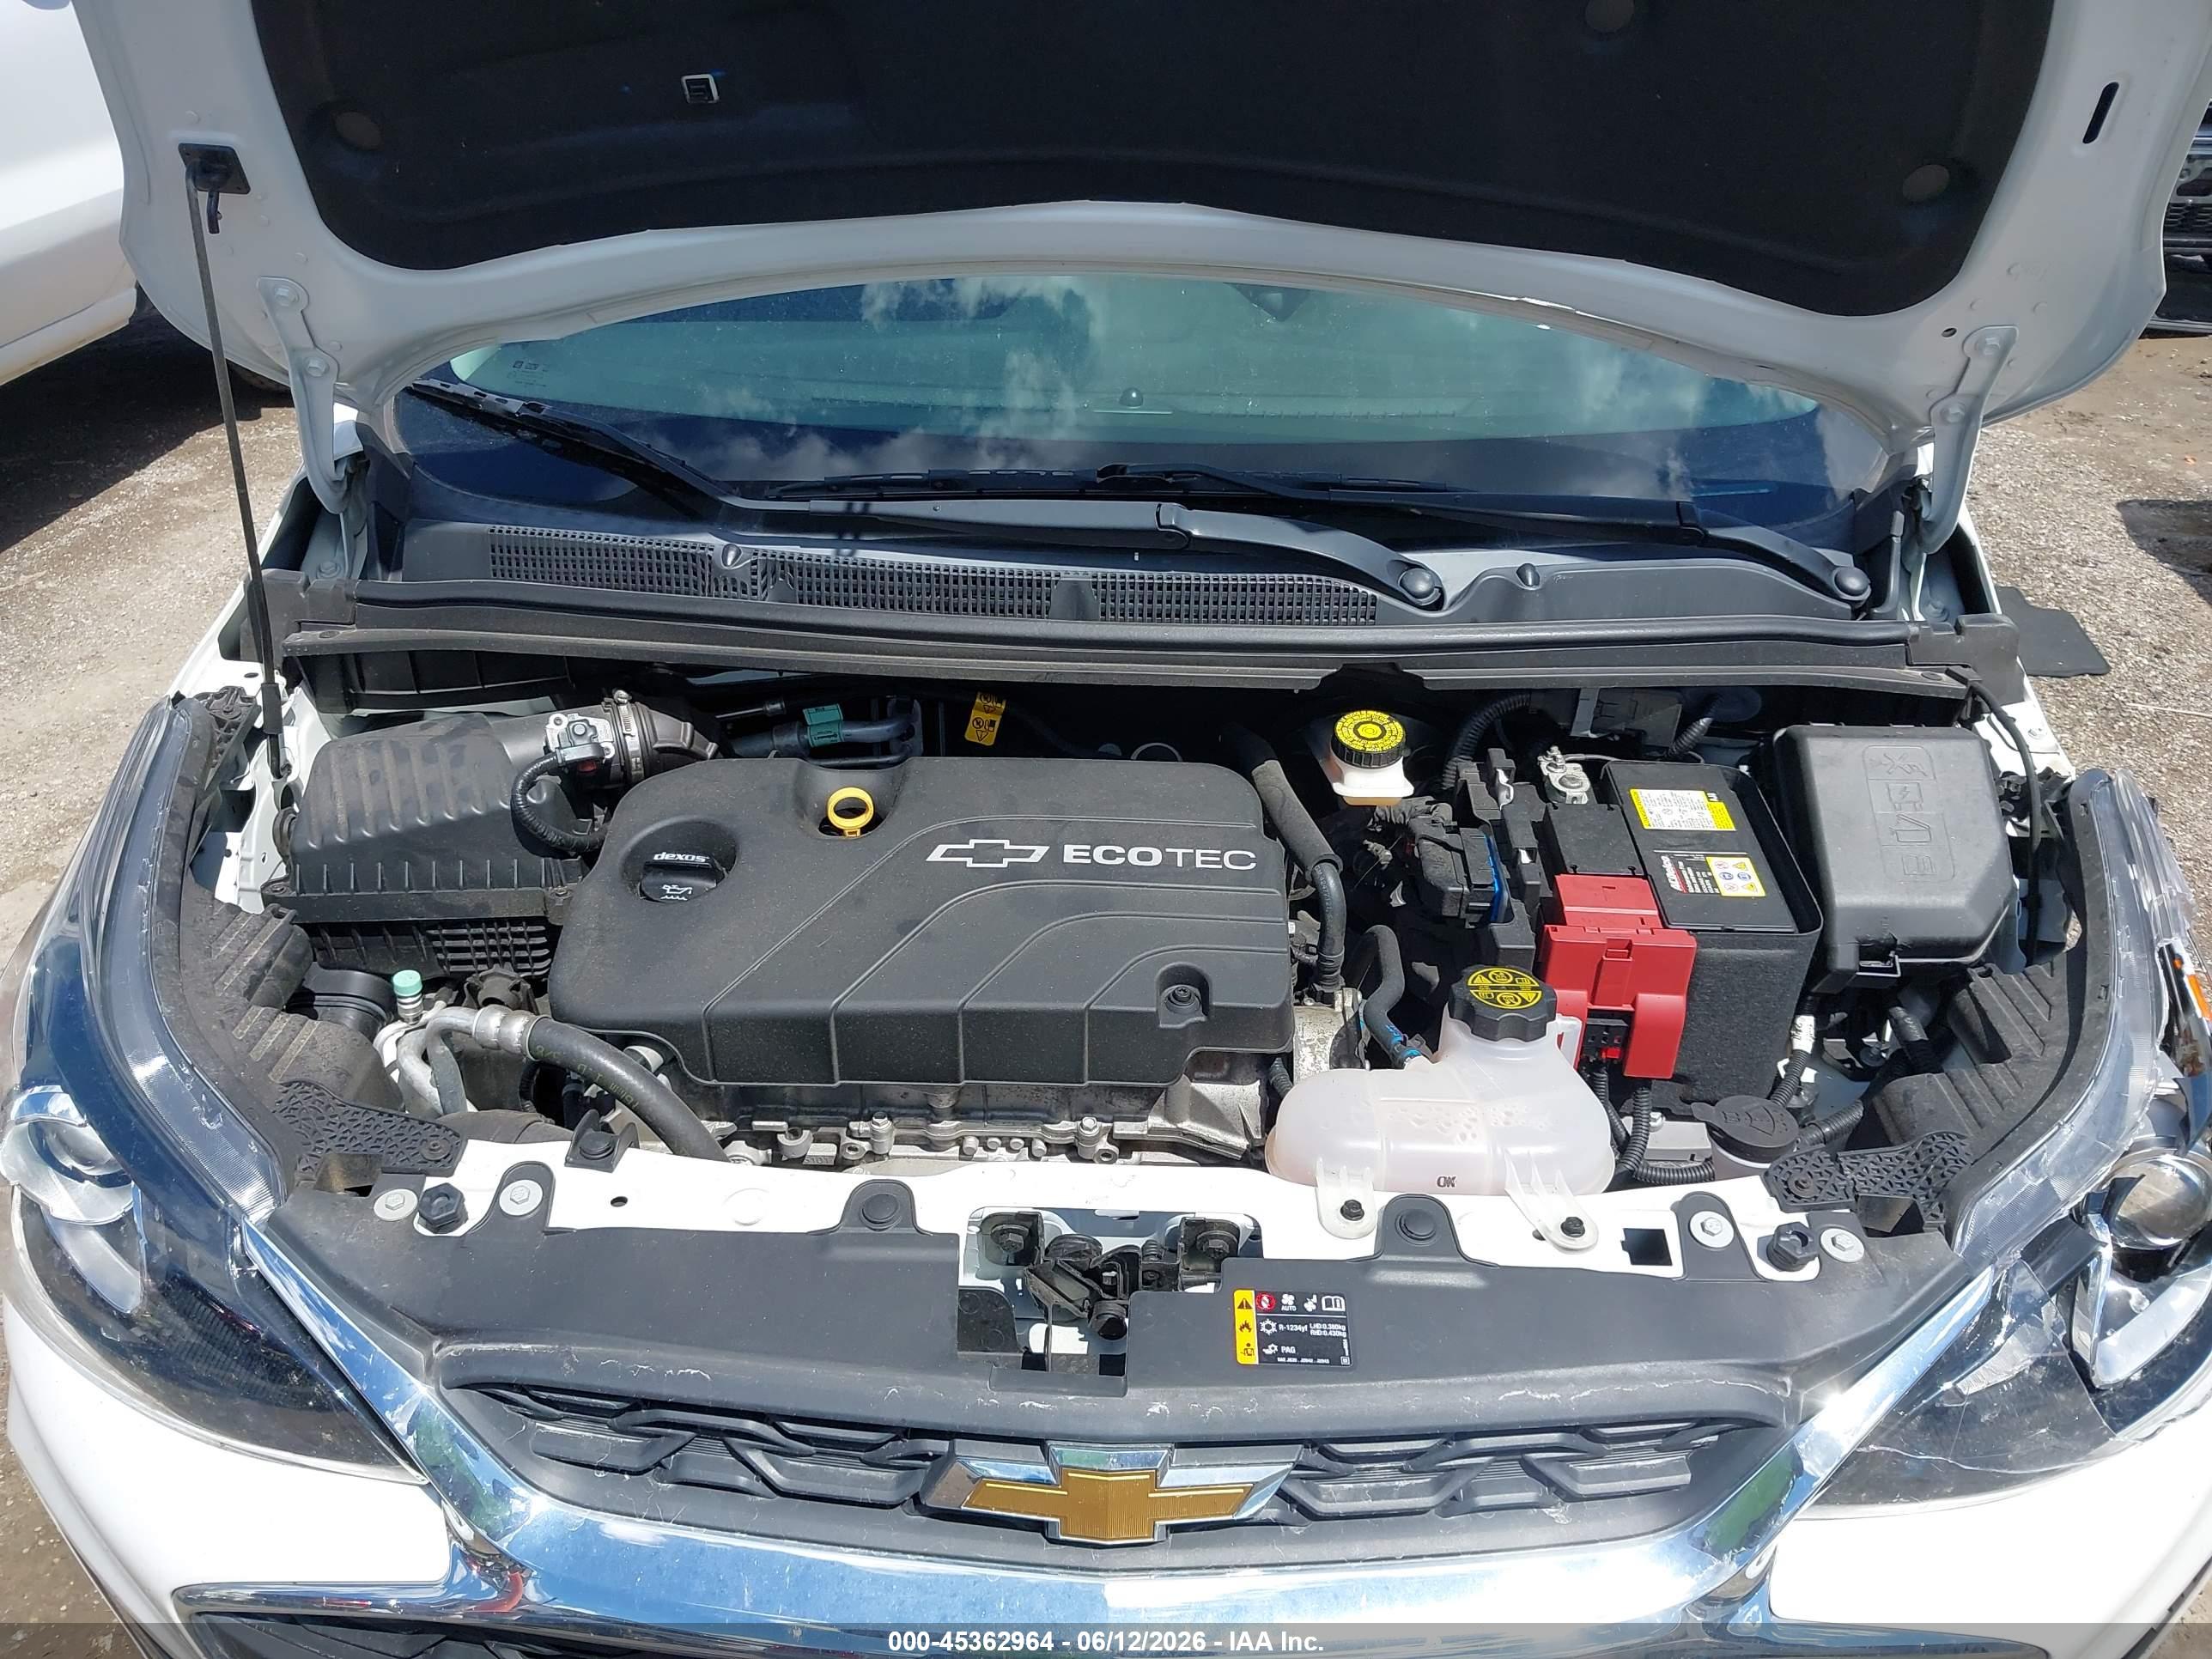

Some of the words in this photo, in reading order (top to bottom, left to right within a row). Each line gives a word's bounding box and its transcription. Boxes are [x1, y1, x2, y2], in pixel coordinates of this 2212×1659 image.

[653, 851, 707, 863] dexos
[1062, 844, 1257, 871] ECOTEC
[1661, 855, 1683, 891] ACDelco
[1279, 1324, 1308, 1333] R-1234yf
